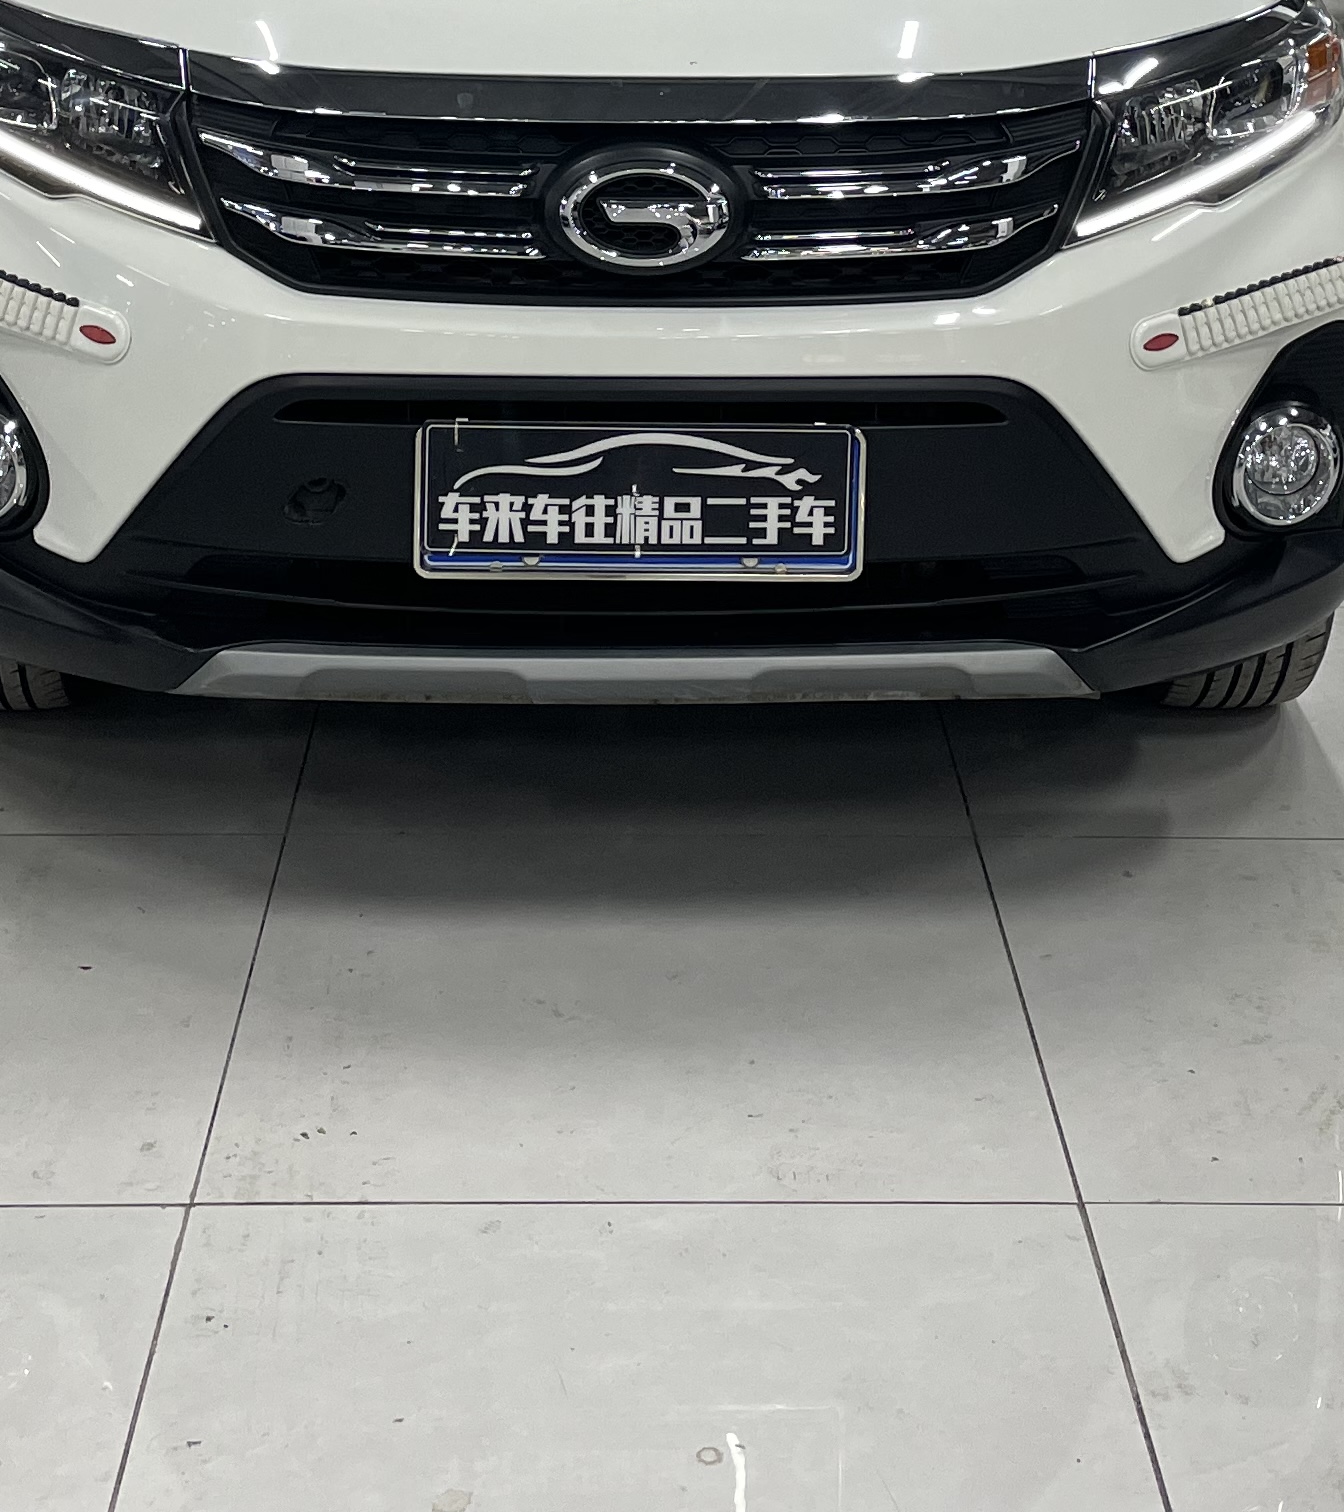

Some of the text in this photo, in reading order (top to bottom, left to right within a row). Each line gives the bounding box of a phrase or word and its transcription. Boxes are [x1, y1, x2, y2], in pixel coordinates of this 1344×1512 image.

[437, 492, 836, 546] 车来车往精品二手车
